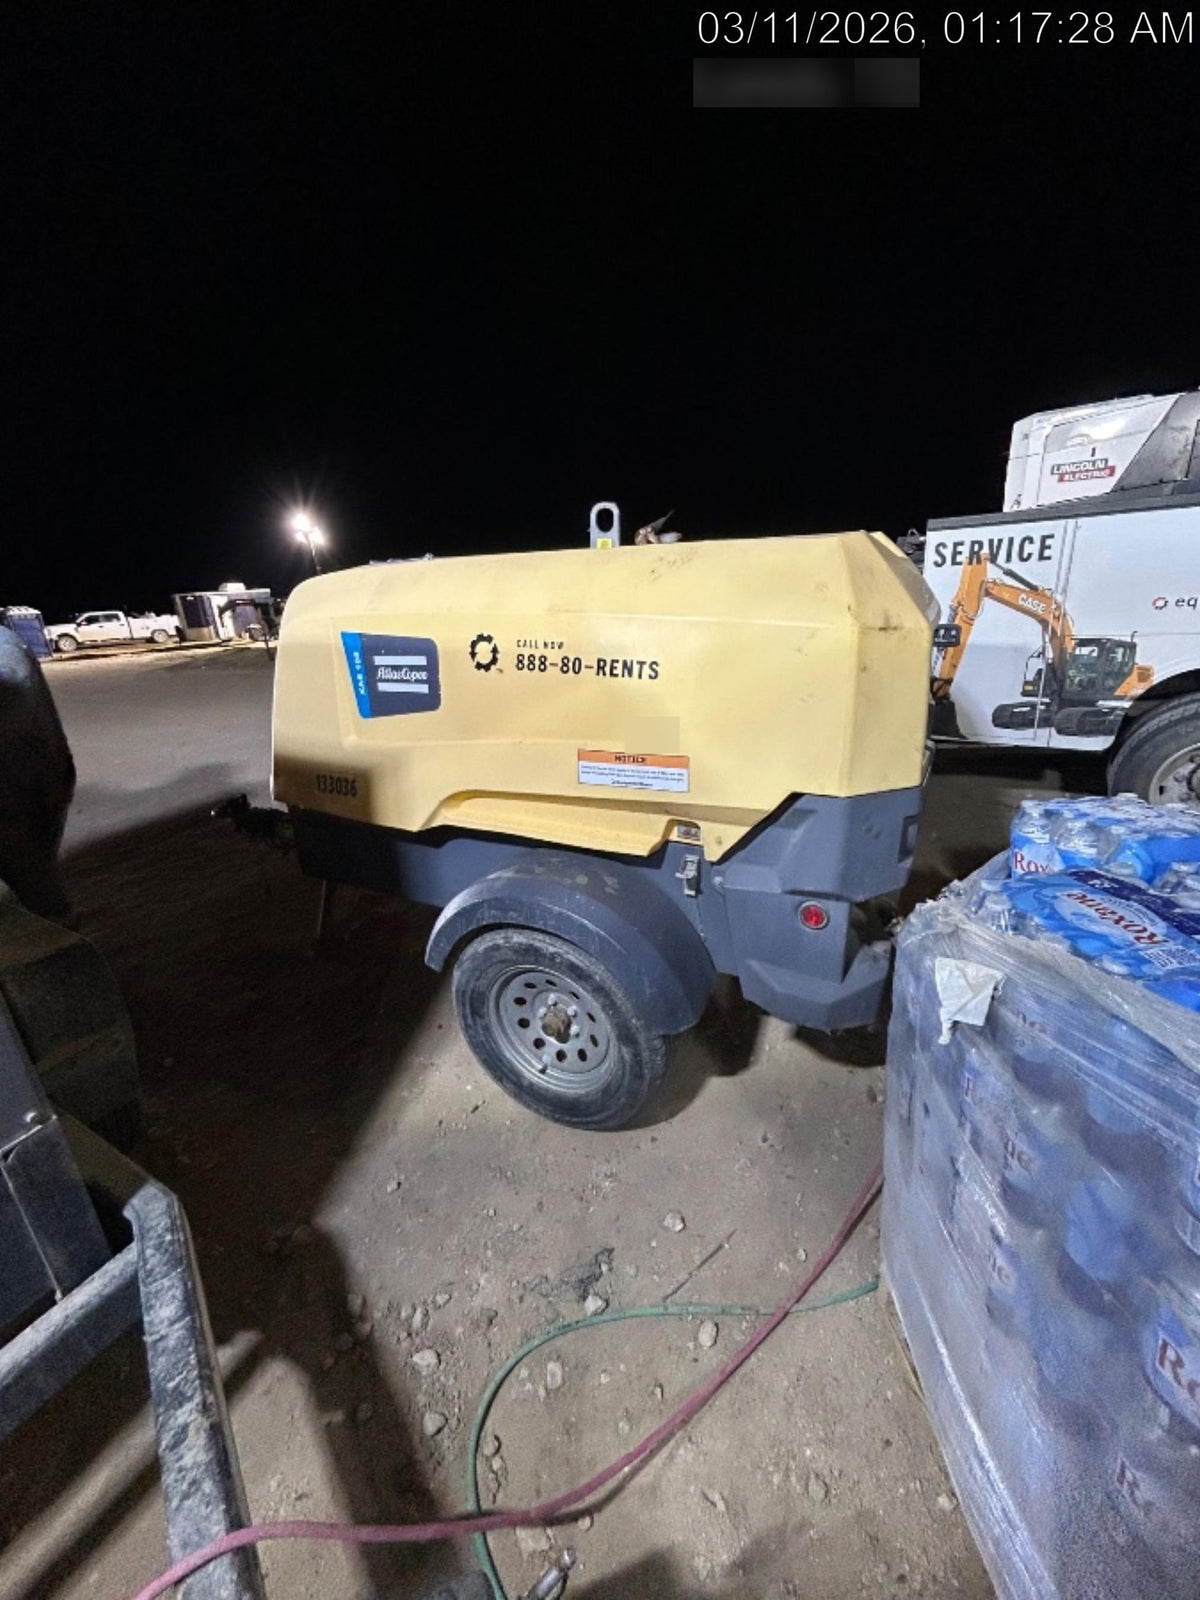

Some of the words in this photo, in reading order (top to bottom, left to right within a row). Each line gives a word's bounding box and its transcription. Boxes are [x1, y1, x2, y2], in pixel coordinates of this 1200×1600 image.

[1053, 460, 1106, 473] LINCOLN
[933, 534, 1055, 568] SERVICE
[1018, 594, 1047, 613] CASE
[516, 639, 539, 650] CALL
[543, 641, 565, 651] NOW
[515, 653, 660, 680] 888-80-RENTS
[315, 774, 358, 798] 133036
